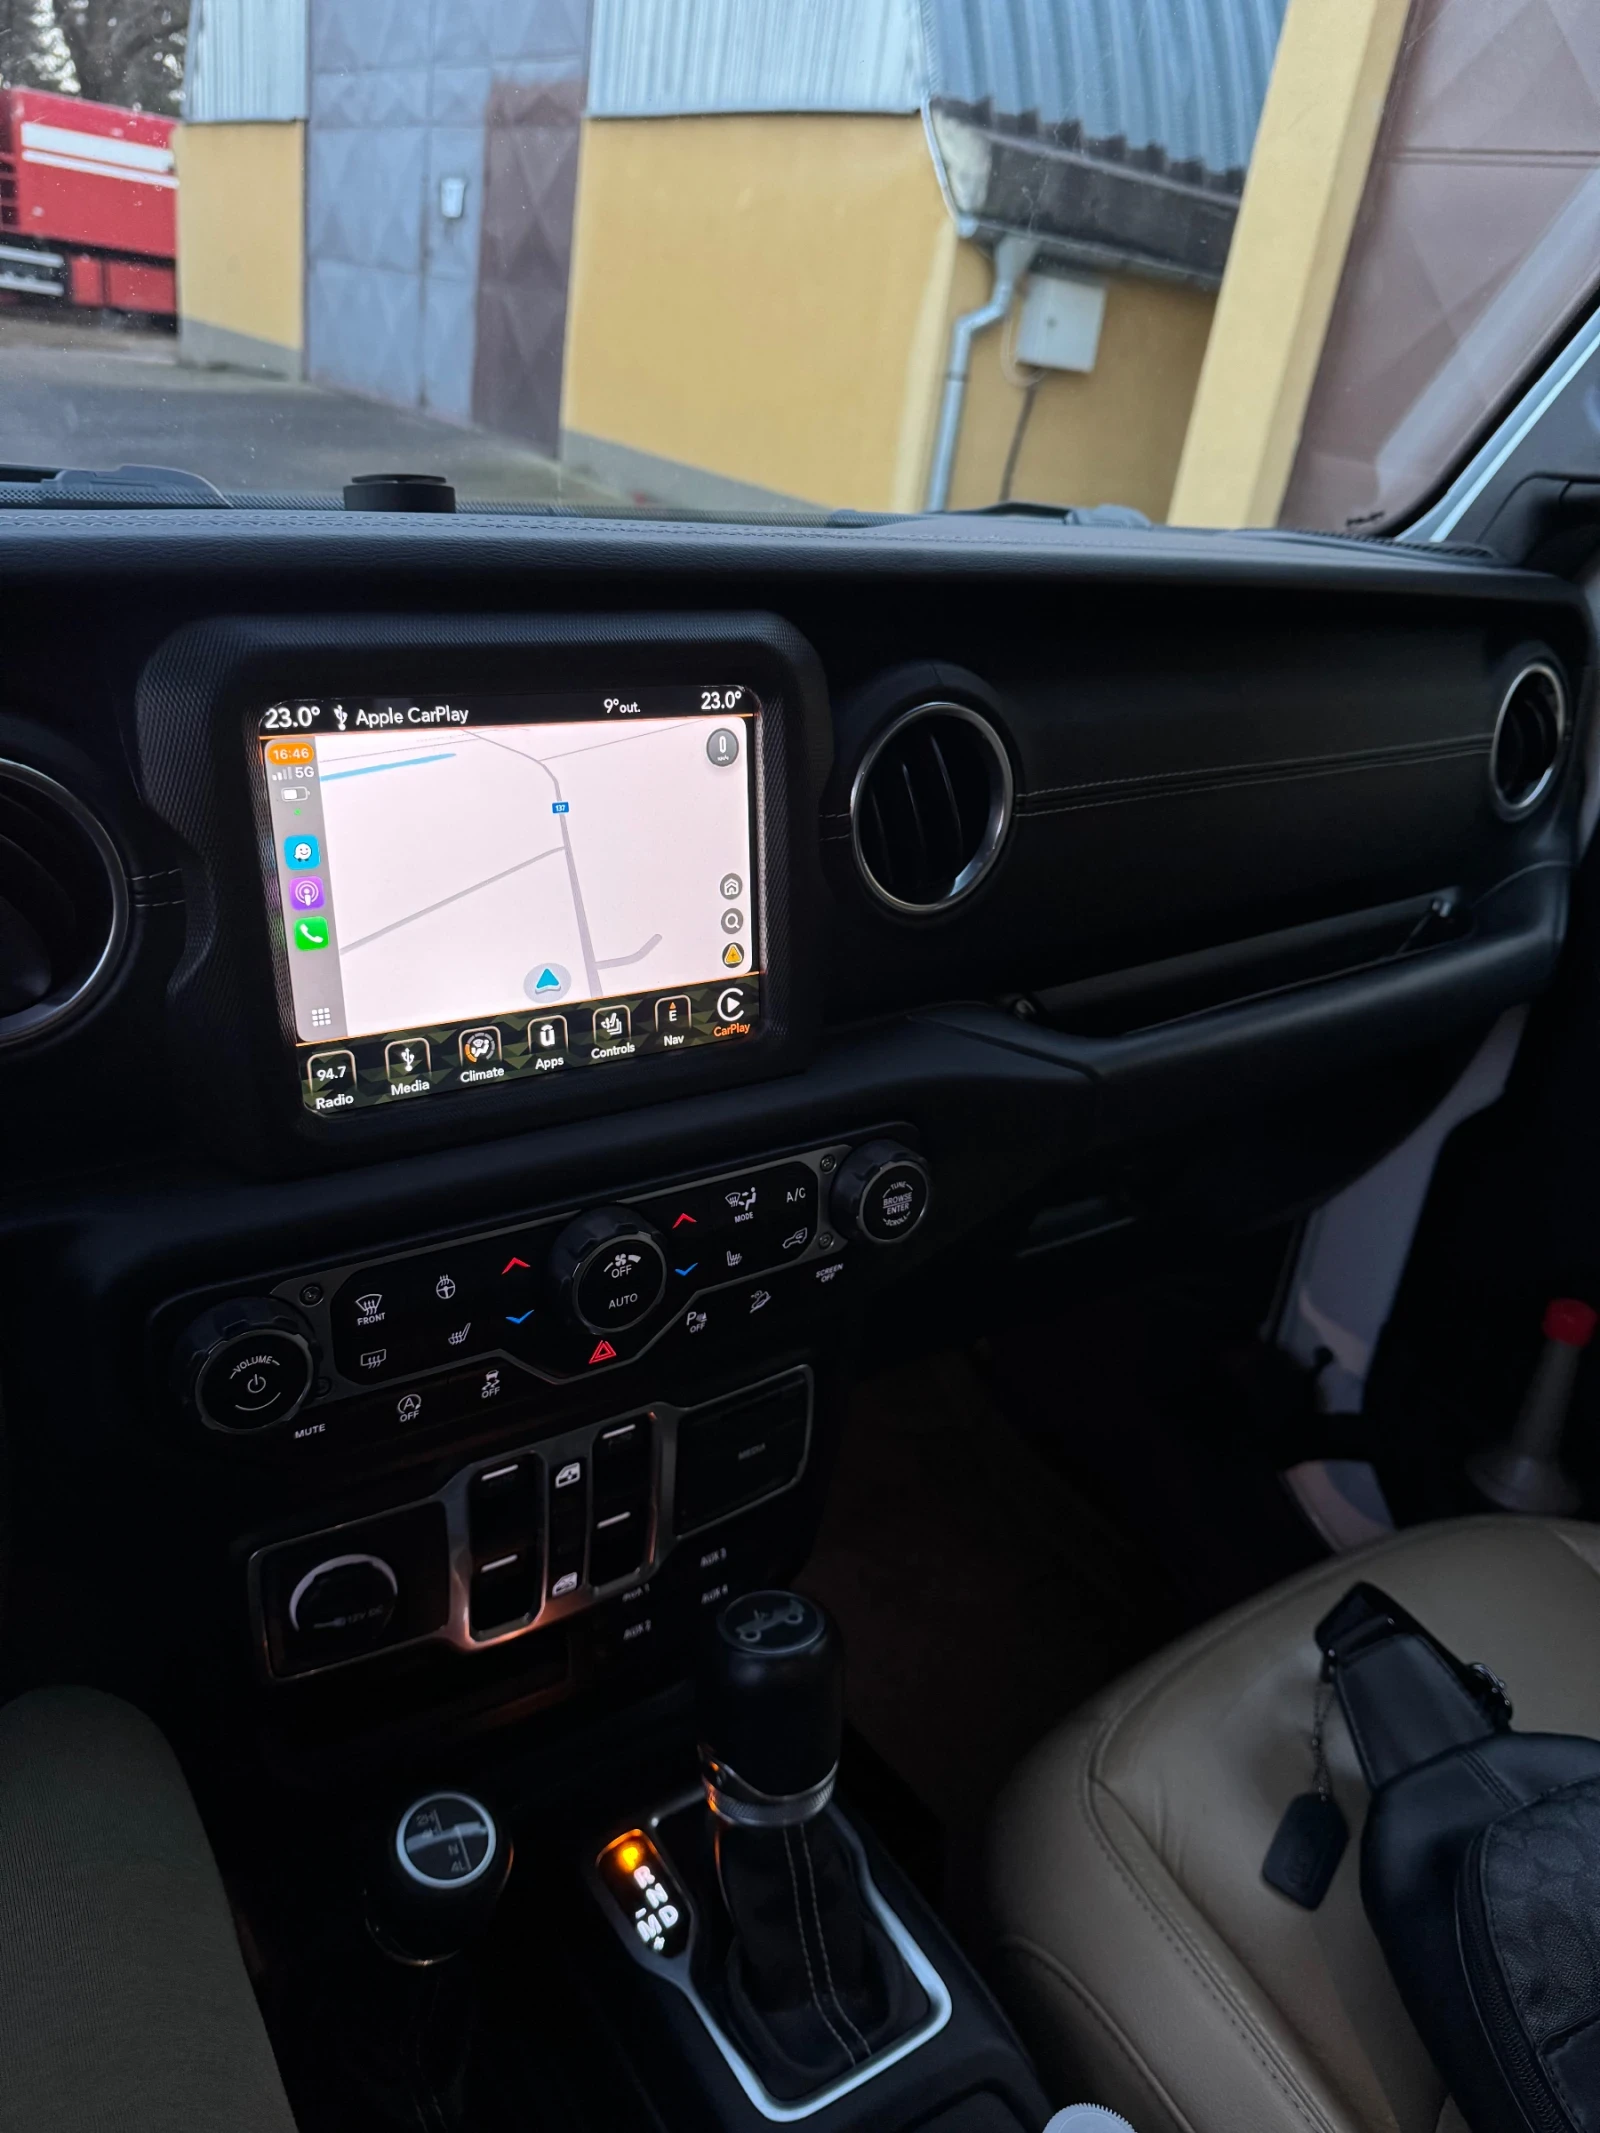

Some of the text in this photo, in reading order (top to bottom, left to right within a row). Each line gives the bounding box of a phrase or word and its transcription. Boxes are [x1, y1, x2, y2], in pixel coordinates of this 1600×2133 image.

[701, 691, 741, 710] 23.0°
[265, 706, 320, 729] 23.0°
[356, 705, 469, 727] Apple CarPlay
[273, 749, 309, 760] 16:46
[295, 767, 314, 778] 5G
[669, 1011, 677, 1022] E
[713, 1023, 751, 1037] CarPlay
[664, 1035, 684, 1046] Nav
[591, 1042, 635, 1059] Controls
[535, 1056, 564, 1070] Apps
[316, 1066, 346, 1081] 94.7
[460, 1067, 505, 1083] Climate
[391, 1080, 430, 1096] Media
[315, 1094, 354, 1109] Radio
[786, 1187, 806, 1203] A/C
[883, 1192, 912, 1206] BROWSE
[886, 1202, 910, 1215] ENTER
[734, 1211, 754, 1223] MODE
[611, 1264, 632, 1279] OFF
[816, 1263, 843, 1278] SCREEN
[821, 1272, 835, 1283] OFF
[608, 1293, 638, 1310] AUTO
[357, 1312, 386, 1326] FRONT
[690, 1323, 705, 1333] OFF
[233, 1355, 273, 1374] VOLUME
[481, 1386, 500, 1399] OFF
[400, 1410, 420, 1422] OFF
[294, 1423, 326, 1439] MUTE
[634, 1865, 655, 1889] R
[645, 1882, 668, 1909] N
[658, 1904, 679, 1928] D
[636, 1913, 662, 1942] M
